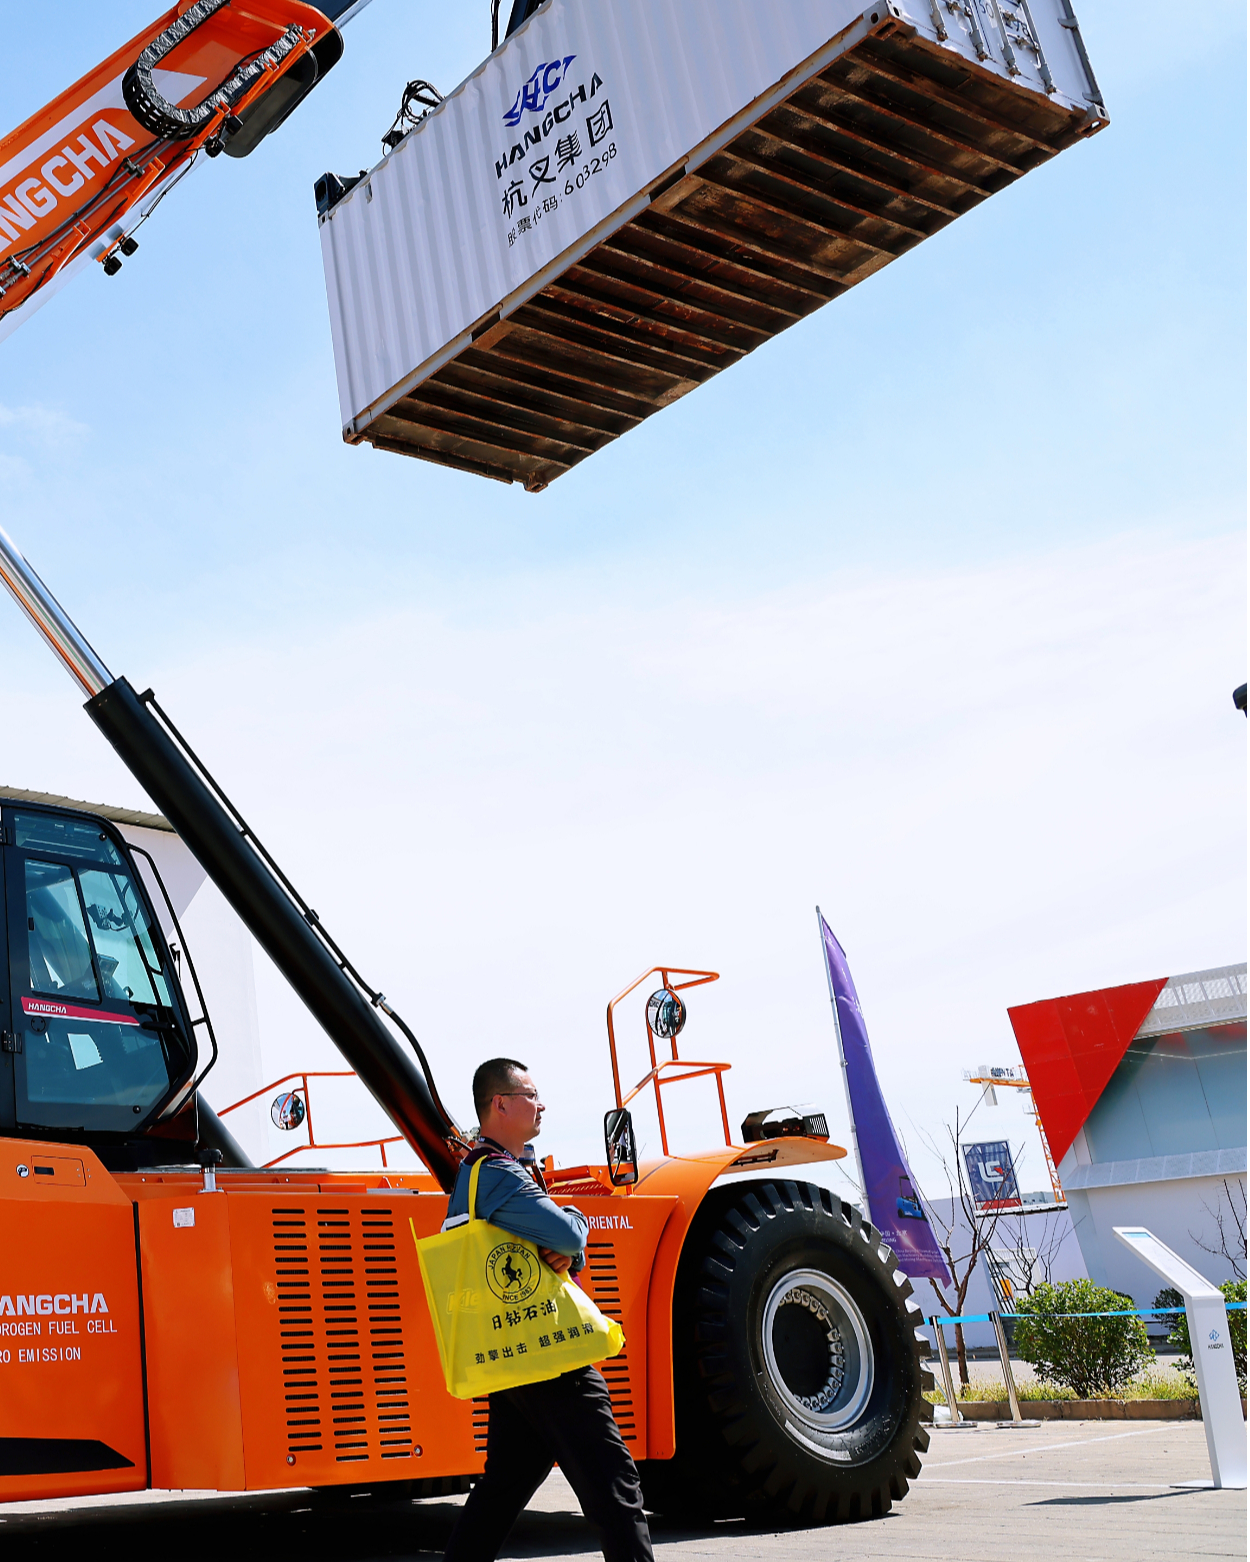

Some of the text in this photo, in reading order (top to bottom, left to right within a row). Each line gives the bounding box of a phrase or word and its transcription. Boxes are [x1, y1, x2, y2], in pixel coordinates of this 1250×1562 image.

[495, 72, 603, 179] HANGCHA
[502, 99, 614, 219] 杭叉集团
[28, 1002, 67, 1014] HANGCHA
[588, 1215, 634, 1229] RIENTAL
[491, 1299, 557, 1330] 日钻石油
[48, 1320, 80, 1335] FUEL
[86, 1319, 118, 1334] CELL
[538, 1322, 595, 1349] 超强润滑
[18, 1346, 82, 1363] EMISSION
